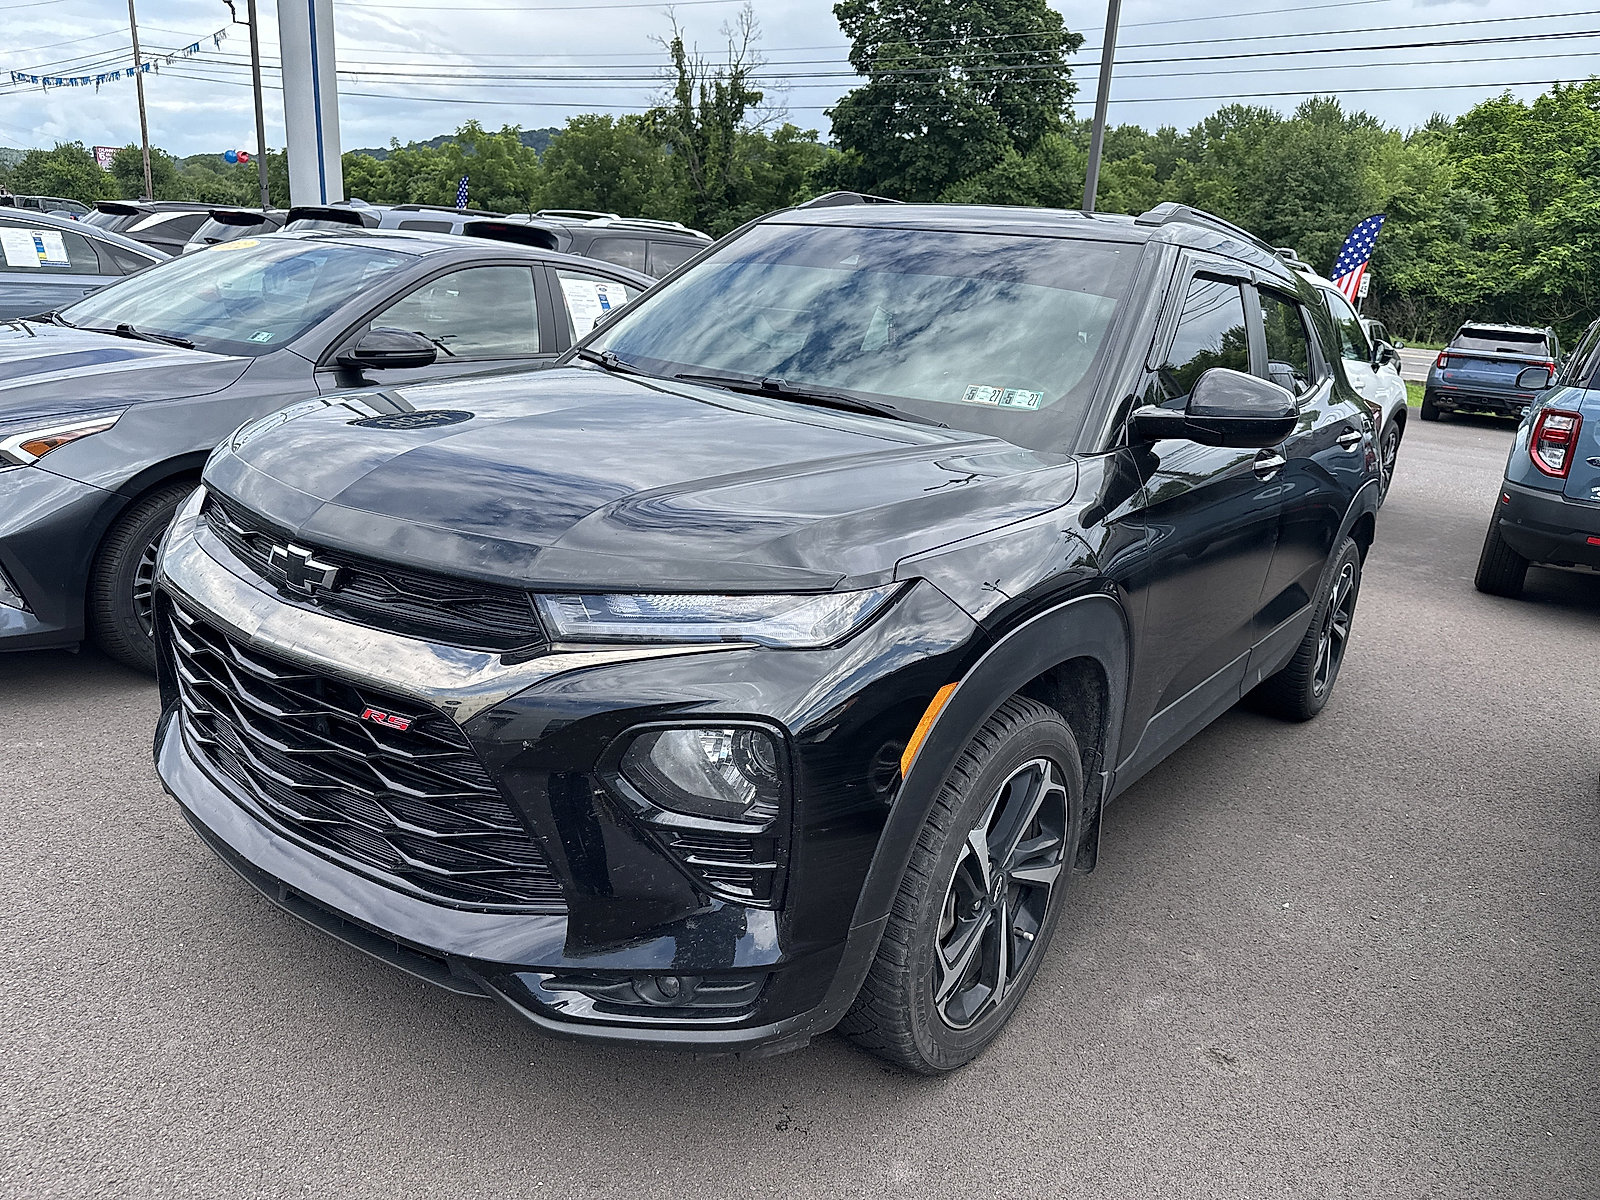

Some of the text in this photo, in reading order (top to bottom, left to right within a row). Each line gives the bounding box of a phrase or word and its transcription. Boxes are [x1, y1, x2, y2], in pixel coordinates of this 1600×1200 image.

[989, 389, 1001, 402] 27
[1027, 393, 1039, 406] 27
[361, 708, 411, 731] RS
